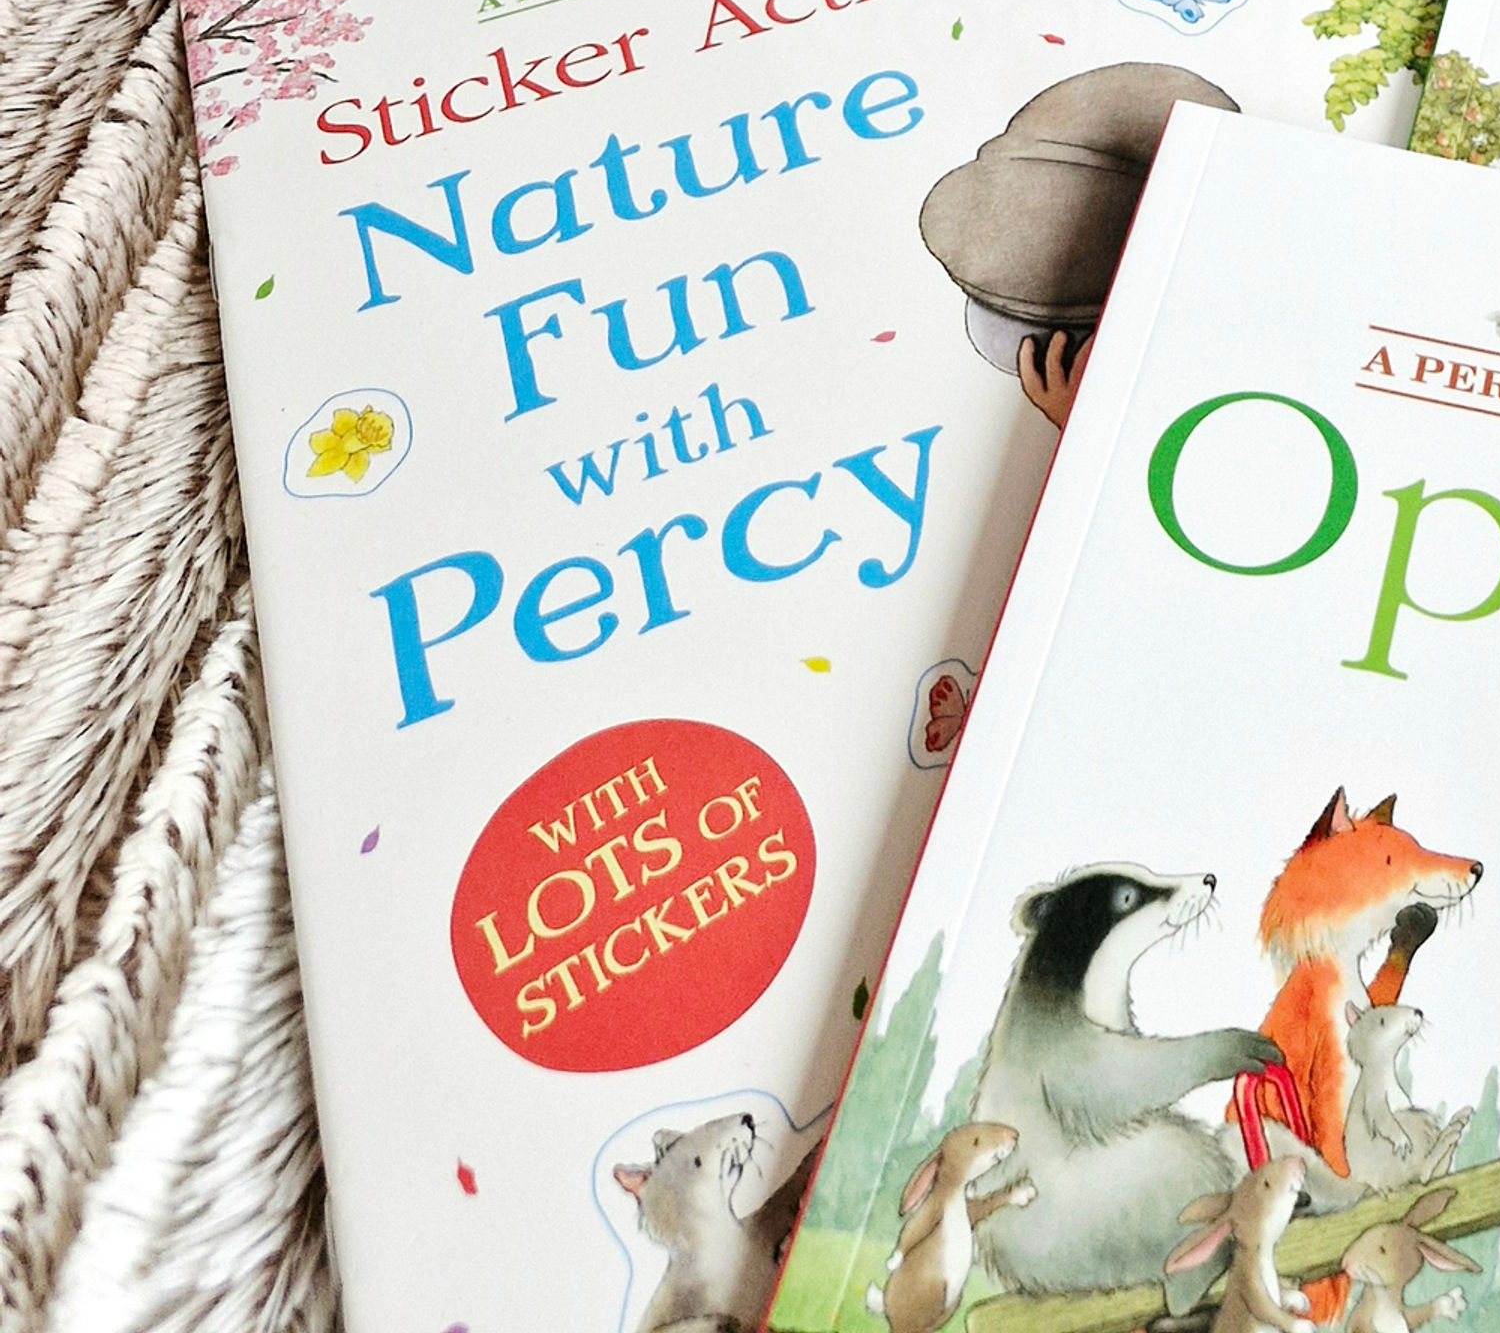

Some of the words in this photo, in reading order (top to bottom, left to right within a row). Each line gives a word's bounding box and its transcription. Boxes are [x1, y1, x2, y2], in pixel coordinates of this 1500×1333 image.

[313, 27, 650, 167] Sticker
[337, 69, 926, 313] Nature
[483, 244, 817, 424] Fun
[1362, 344, 1397, 375] A
[545, 382, 775, 506] with
[369, 423, 944, 732] Percy
[475, 808, 684, 975] LOTS
[698, 775, 764, 841] OF
[528, 757, 670, 854] WITH
[516, 828, 798, 1038] STICKERS
